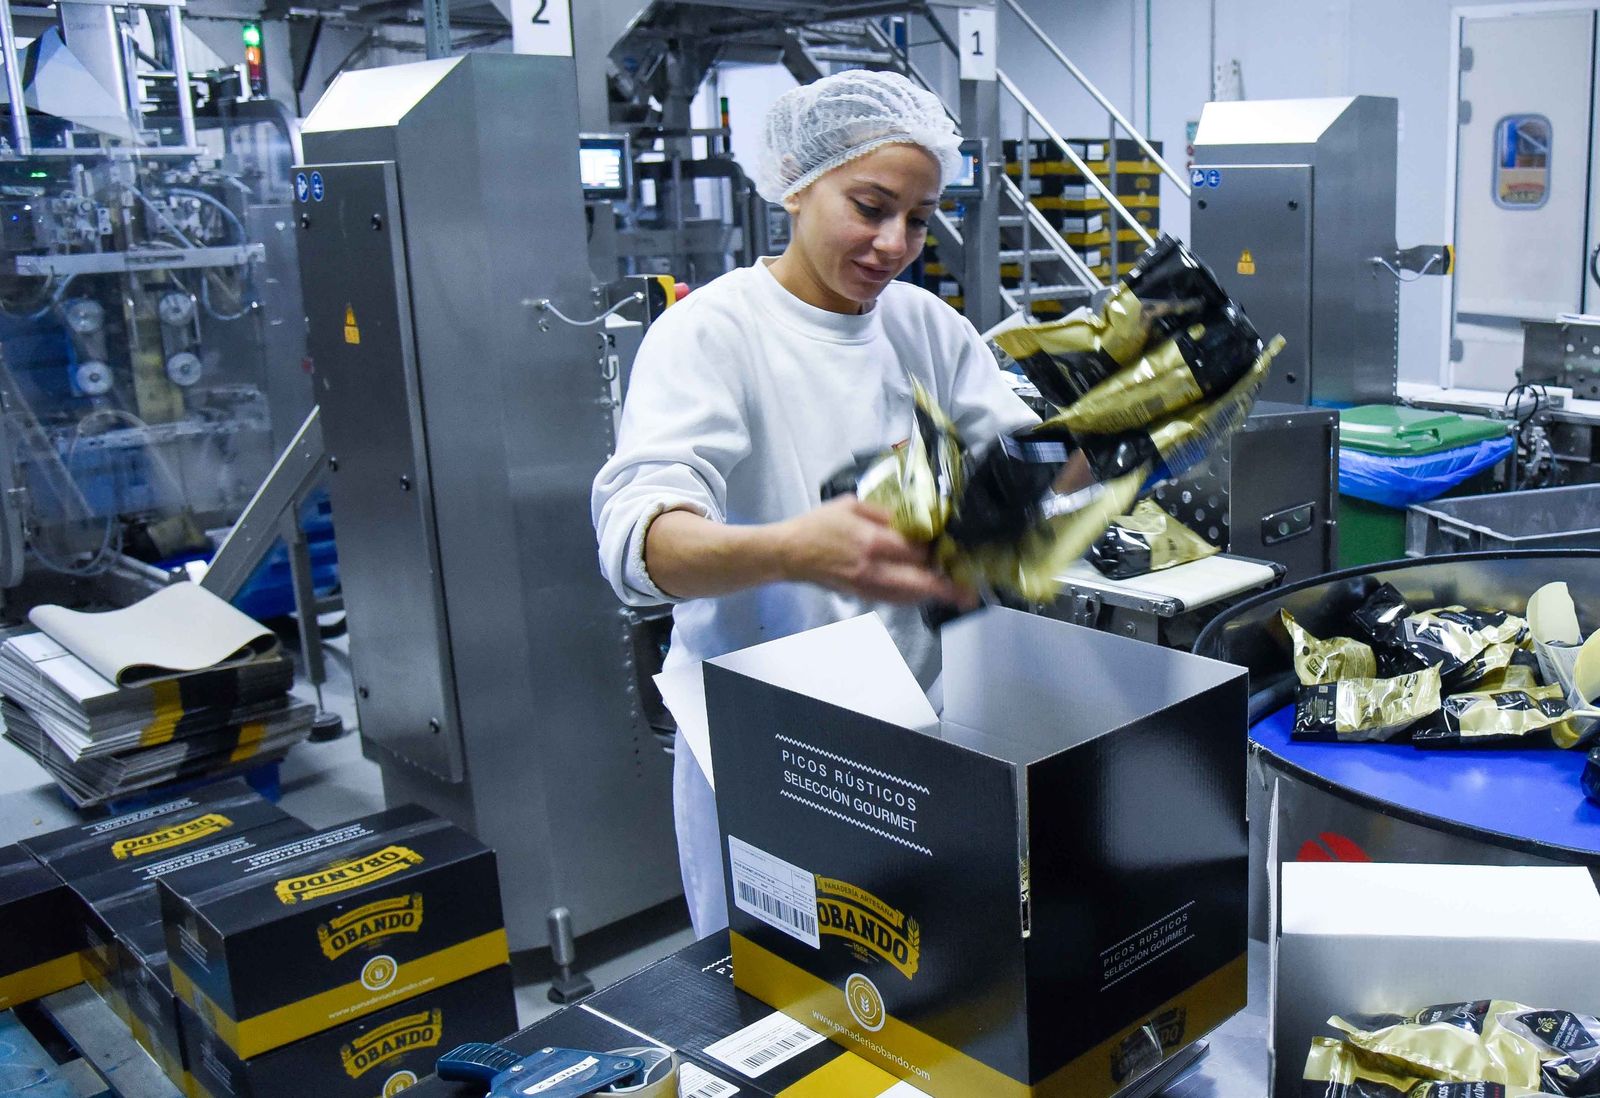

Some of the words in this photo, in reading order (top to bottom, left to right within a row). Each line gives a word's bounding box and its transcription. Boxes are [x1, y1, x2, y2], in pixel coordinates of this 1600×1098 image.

[532, 0, 550, 24] 2
[972, 30, 984, 55] 1
[782, 749, 827, 777] PICOS
[834, 769, 917, 811] RÚSTICOS
[784, 770, 850, 807] SELECCIÓN
[853, 797, 917, 833] GOURMET
[122, 816, 215, 850] OBANDO
[288, 852, 400, 891] OBANDO
[330, 912, 414, 951] OBANDO
[816, 901, 909, 966] OBANDO
[1150, 925, 1188, 952] GOURMET
[1103, 943, 1135, 967] PICOS
[354, 1027, 433, 1069] OBANDO
[812, 1009, 931, 1081] www.panaderiaobando.com
